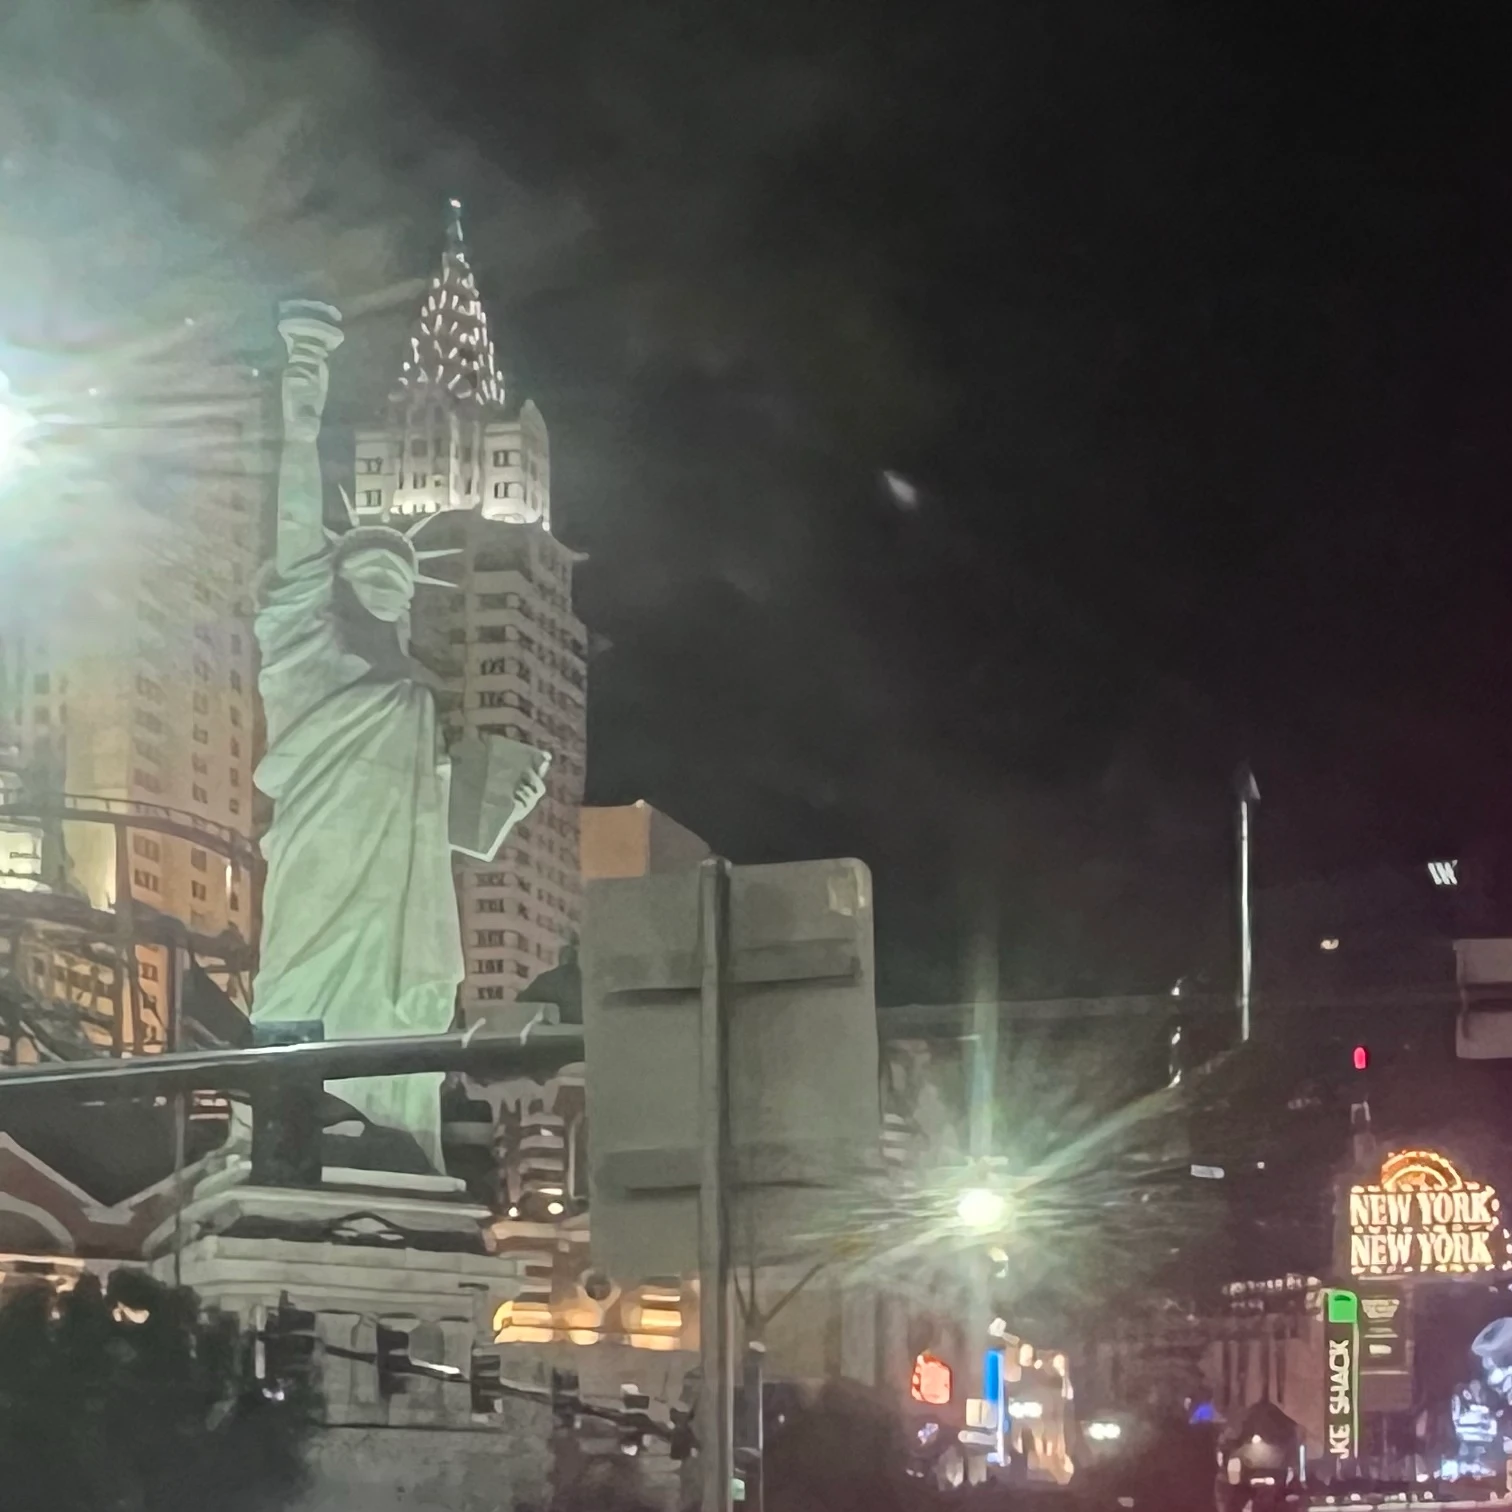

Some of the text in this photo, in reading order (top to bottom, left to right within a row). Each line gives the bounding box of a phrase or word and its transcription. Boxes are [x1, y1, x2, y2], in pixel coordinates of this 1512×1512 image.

[1350, 1191, 1492, 1226] NEW YORK
[1351, 1231, 1493, 1267] NEW YORK
[1328, 1339, 1351, 1415] SHACK
